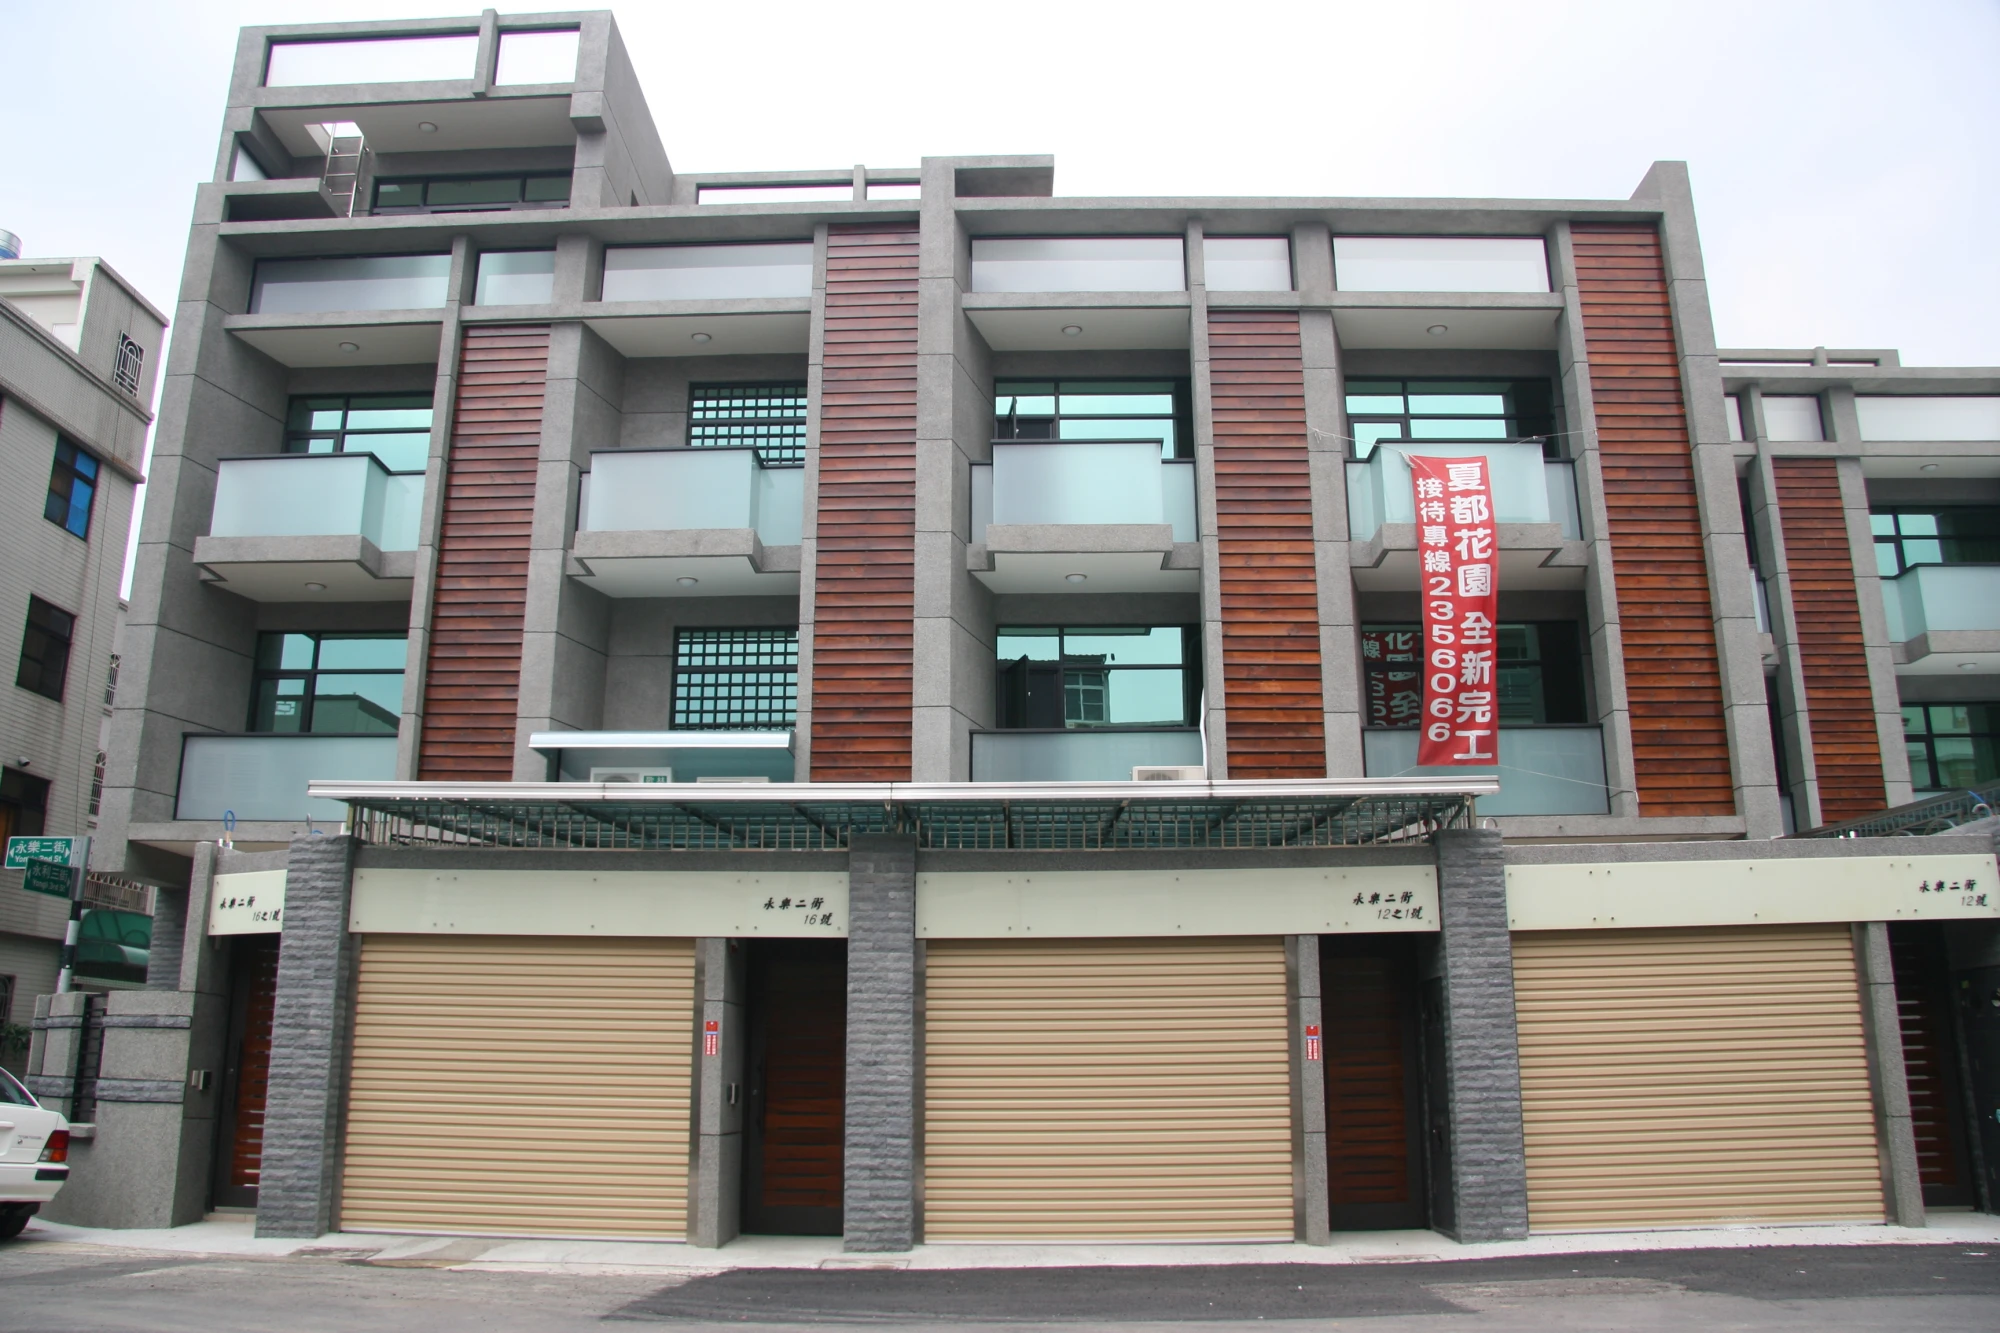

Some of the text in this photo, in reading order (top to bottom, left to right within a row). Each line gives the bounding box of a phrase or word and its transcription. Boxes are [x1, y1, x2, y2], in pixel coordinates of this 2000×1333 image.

[1445, 461, 1492, 760] 夏都花園 全新完工
[15, 840, 67, 854] 永樂二街
[32, 862, 69, 882] 永利三街
[1919, 879, 1976, 893] 永樂二街
[763, 897, 824, 910] 永樂二街
[1353, 891, 1413, 905] 永樂二街
[1961, 893, 1987, 906] 12號
[804, 912, 833, 926] 16號
[1377, 906, 1423, 919] 12之1號
